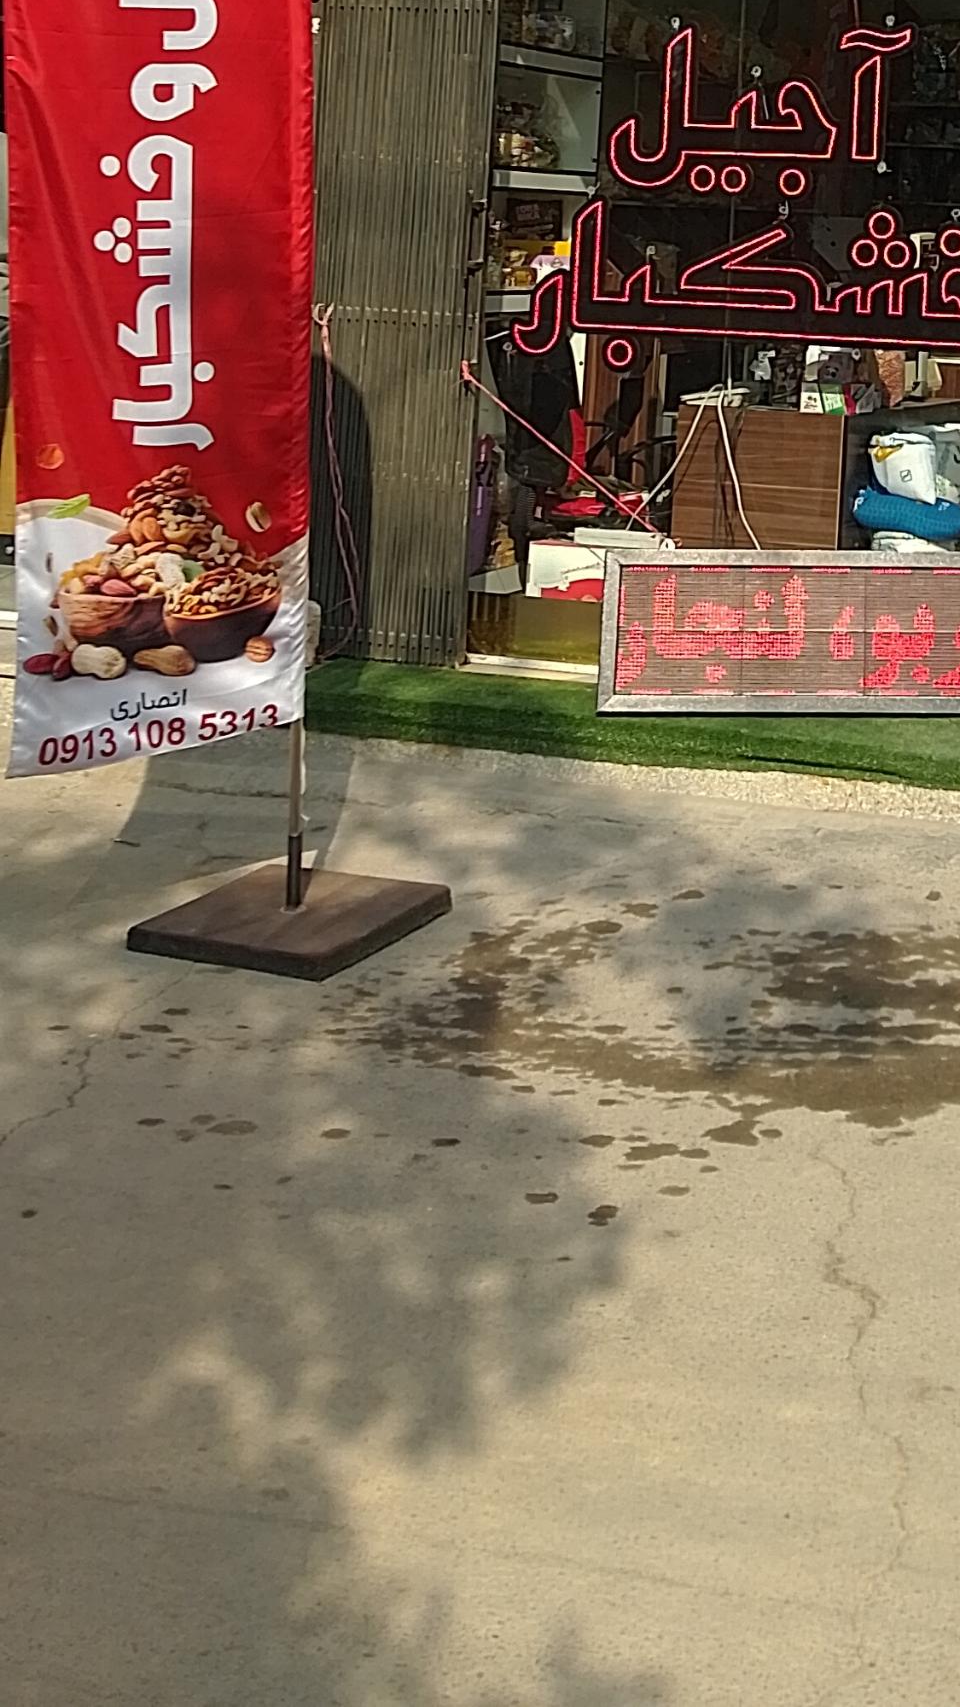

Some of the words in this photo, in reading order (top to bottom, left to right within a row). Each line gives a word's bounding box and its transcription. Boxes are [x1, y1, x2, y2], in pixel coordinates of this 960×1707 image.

[130, 63, 218, 122] و
[610, 27, 912, 196] آجیل
[93, 133, 216, 452] خشکبار
[38, 727, 118, 766] 0913
[127, 717, 186, 752] 108
[197, 703, 279, 741] 5313
[110, 688, 187, 722] انصاری
